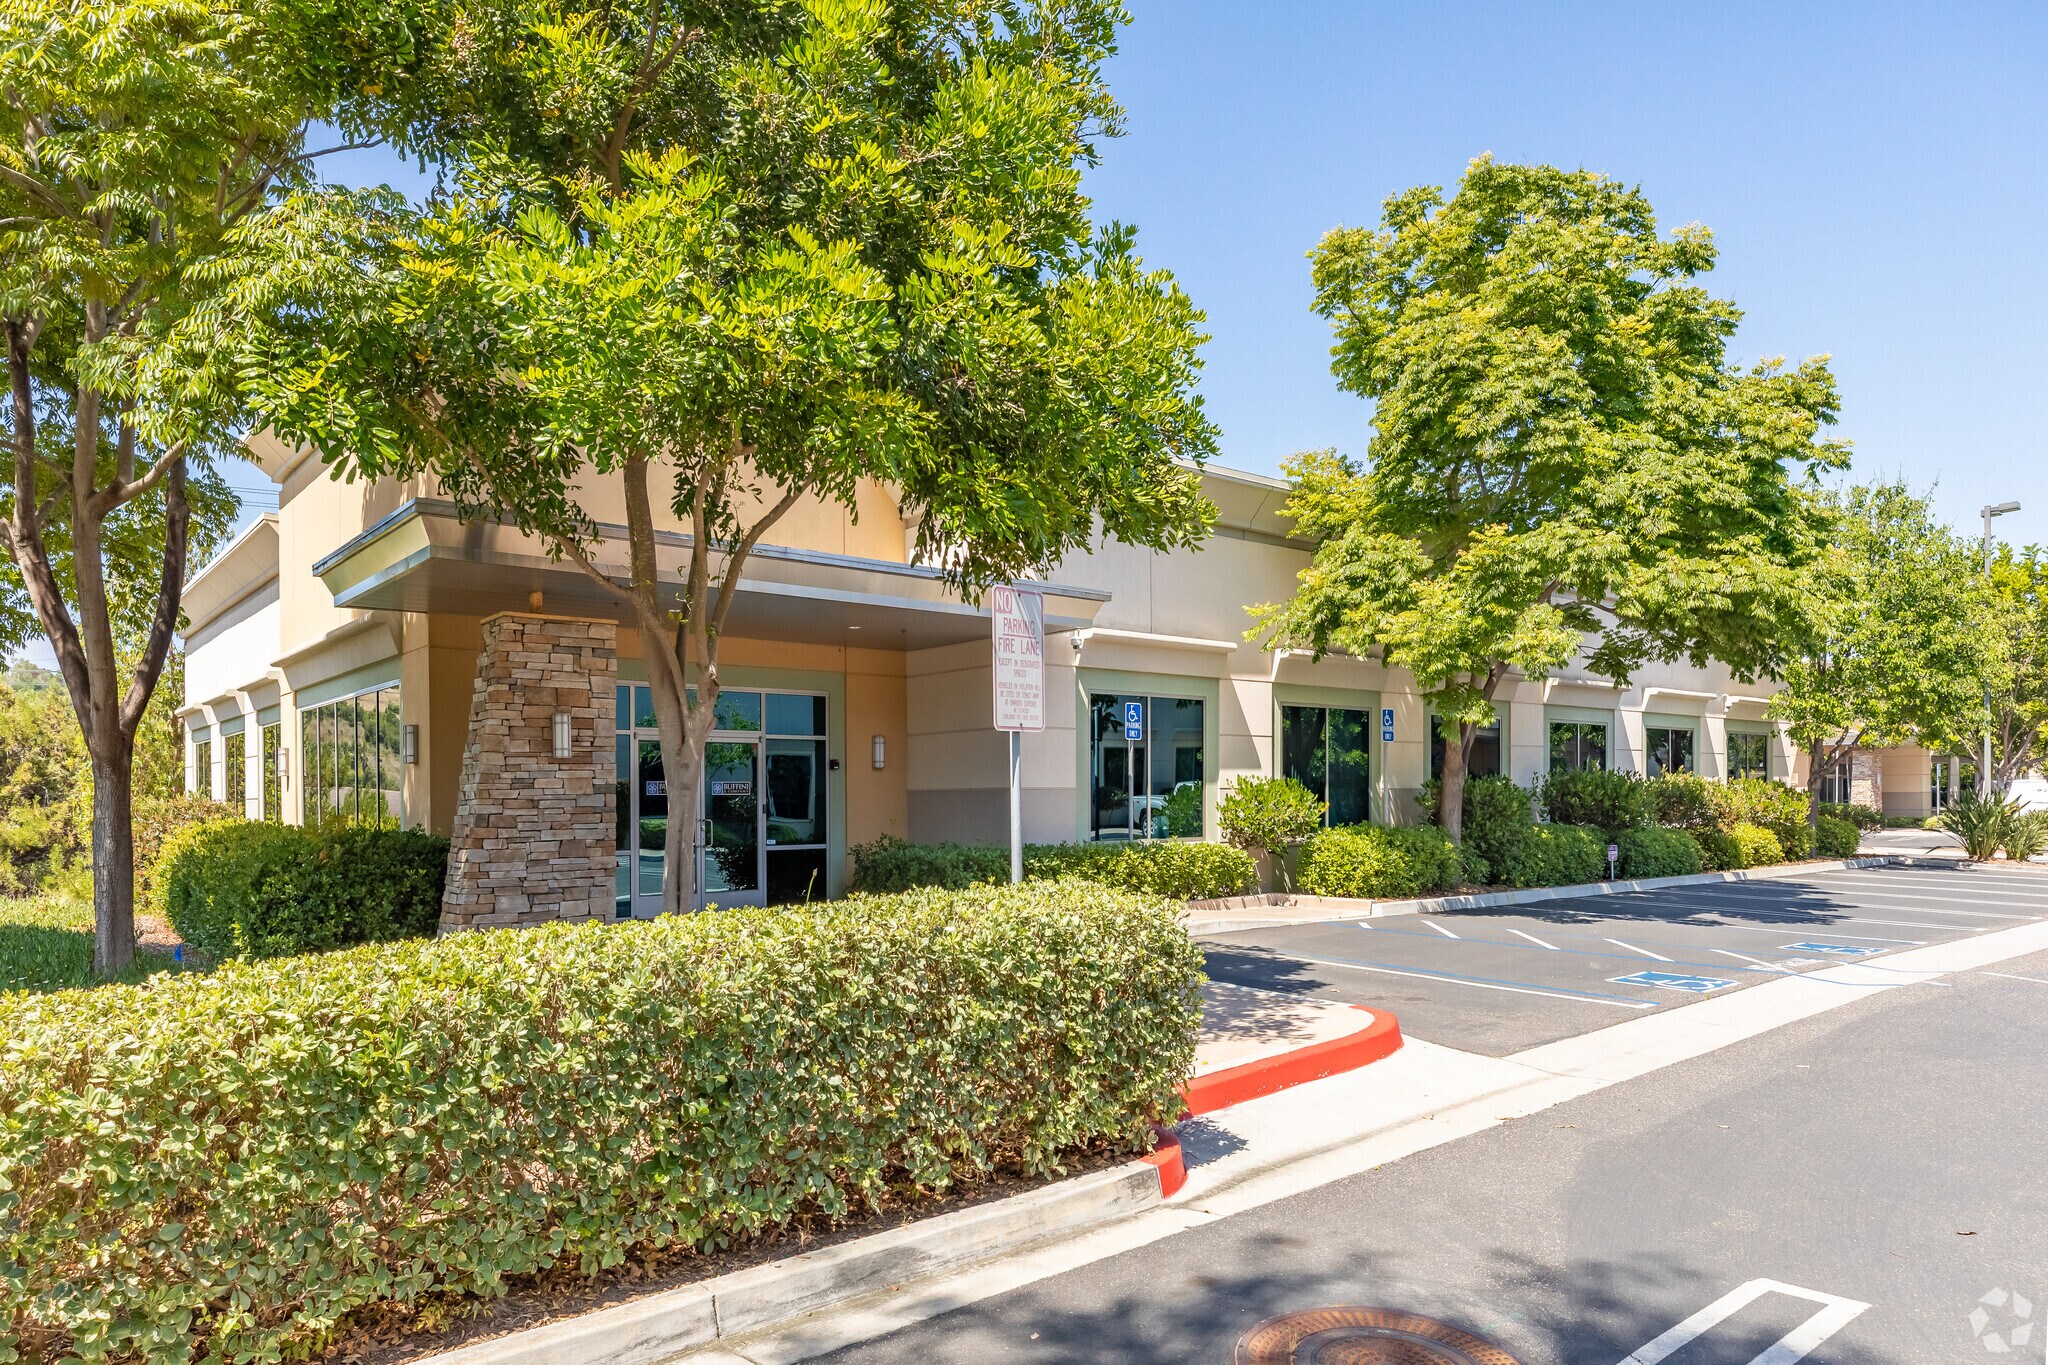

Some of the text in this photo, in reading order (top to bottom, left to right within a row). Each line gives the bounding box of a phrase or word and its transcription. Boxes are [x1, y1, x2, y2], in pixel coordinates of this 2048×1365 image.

[996, 590, 1012, 612] NO
[1003, 618, 1035, 635] PARKING
[998, 637, 1040, 655] FIRE LANE
[998, 657, 1040, 669] EXCEPT IN DESIGNATED
[1013, 669, 1027, 678] SPACES
